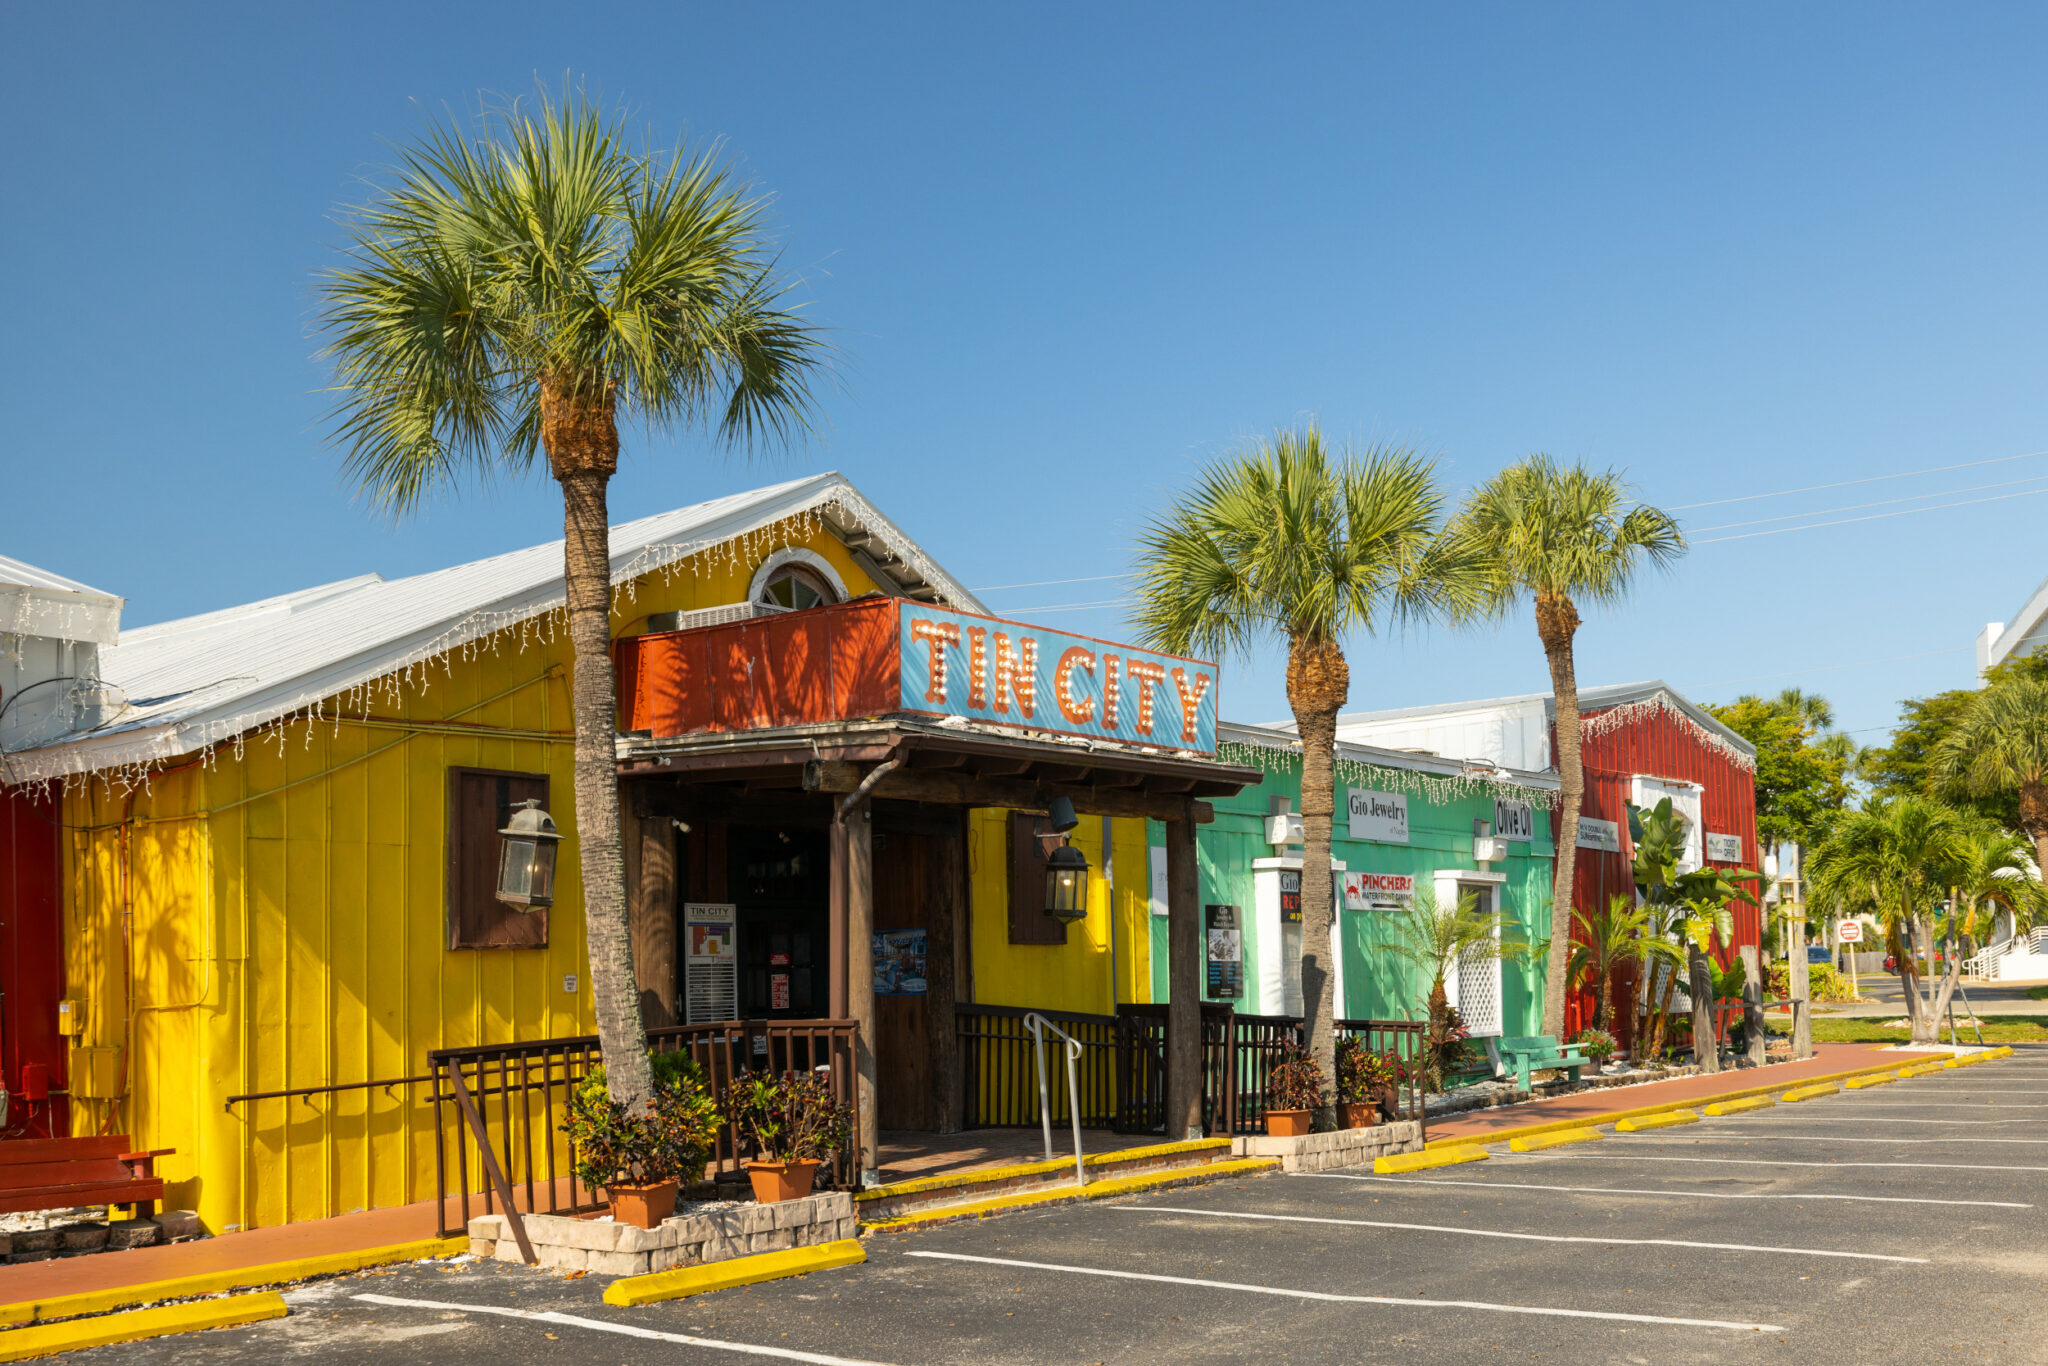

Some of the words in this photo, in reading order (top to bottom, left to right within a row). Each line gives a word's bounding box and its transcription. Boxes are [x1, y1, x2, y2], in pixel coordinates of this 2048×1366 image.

[910, 617, 1036, 719] TIN
[1054, 645, 1210, 744] CITY
[1370, 797, 1406, 826] Jewelry
[1497, 800, 1518, 835] Olive
[1521, 803, 1532, 836] Oil
[1361, 873, 1412, 891] PINCHERS
[1361, 892, 1395, 900] WATERFRONT
[690, 907, 705, 915] TIN
[708, 908, 729, 916] CITY
